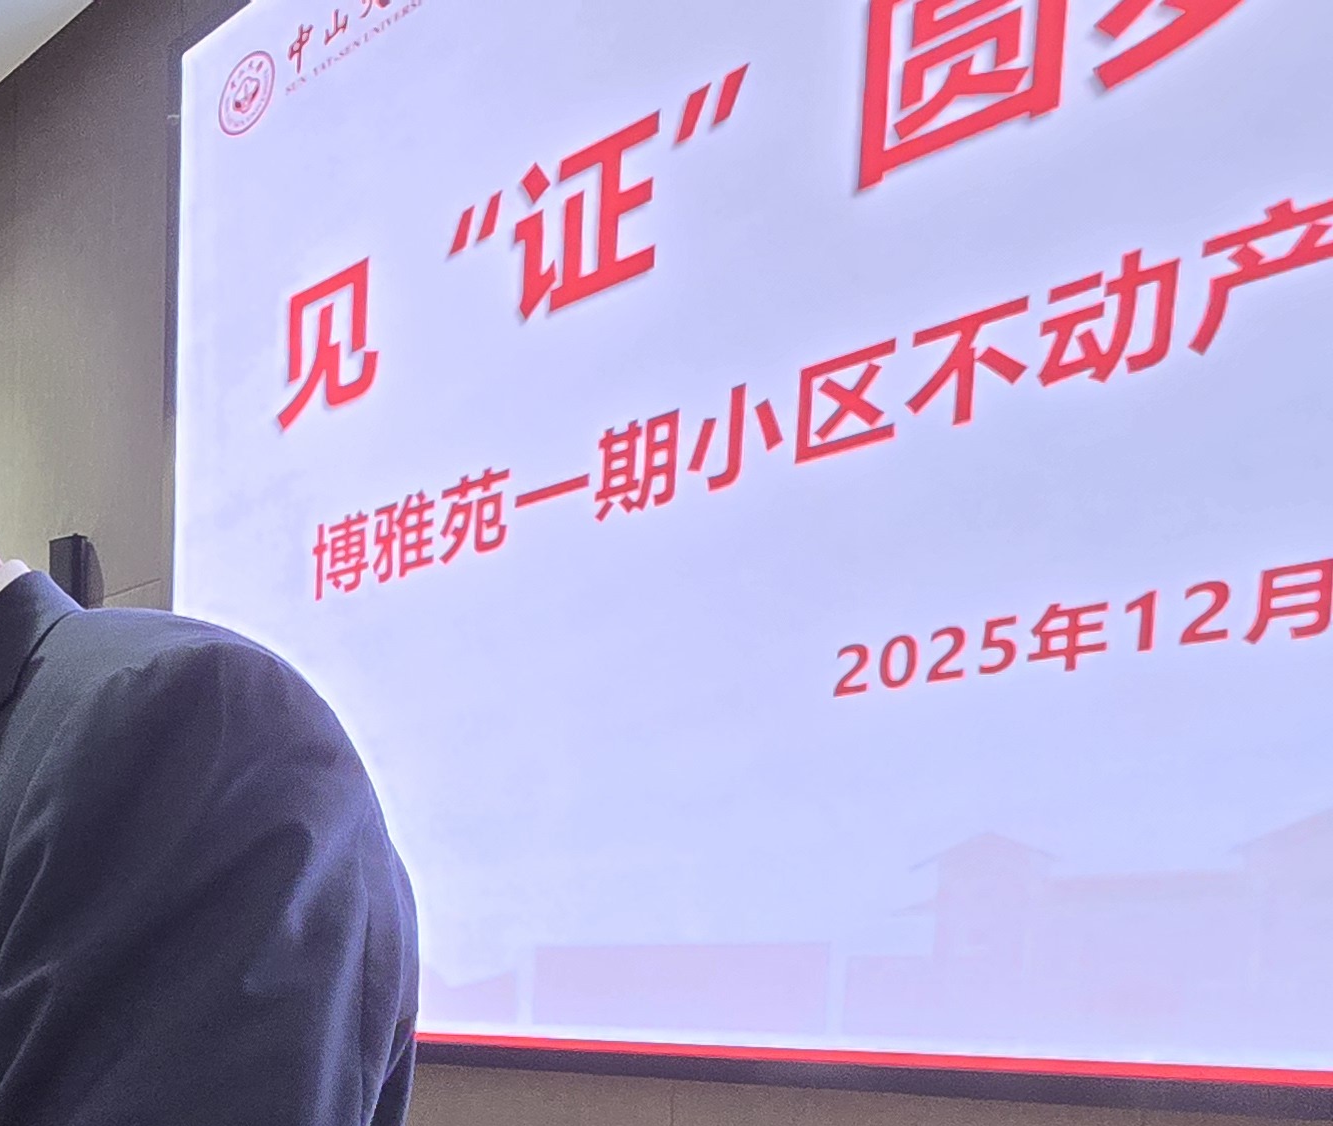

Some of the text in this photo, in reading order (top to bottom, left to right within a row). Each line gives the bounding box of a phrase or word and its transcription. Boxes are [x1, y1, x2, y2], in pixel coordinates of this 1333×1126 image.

[312, 198, 1333, 601] 博雅苑一期小区不动产
[833, 558, 1333, 698] 2025年12月
